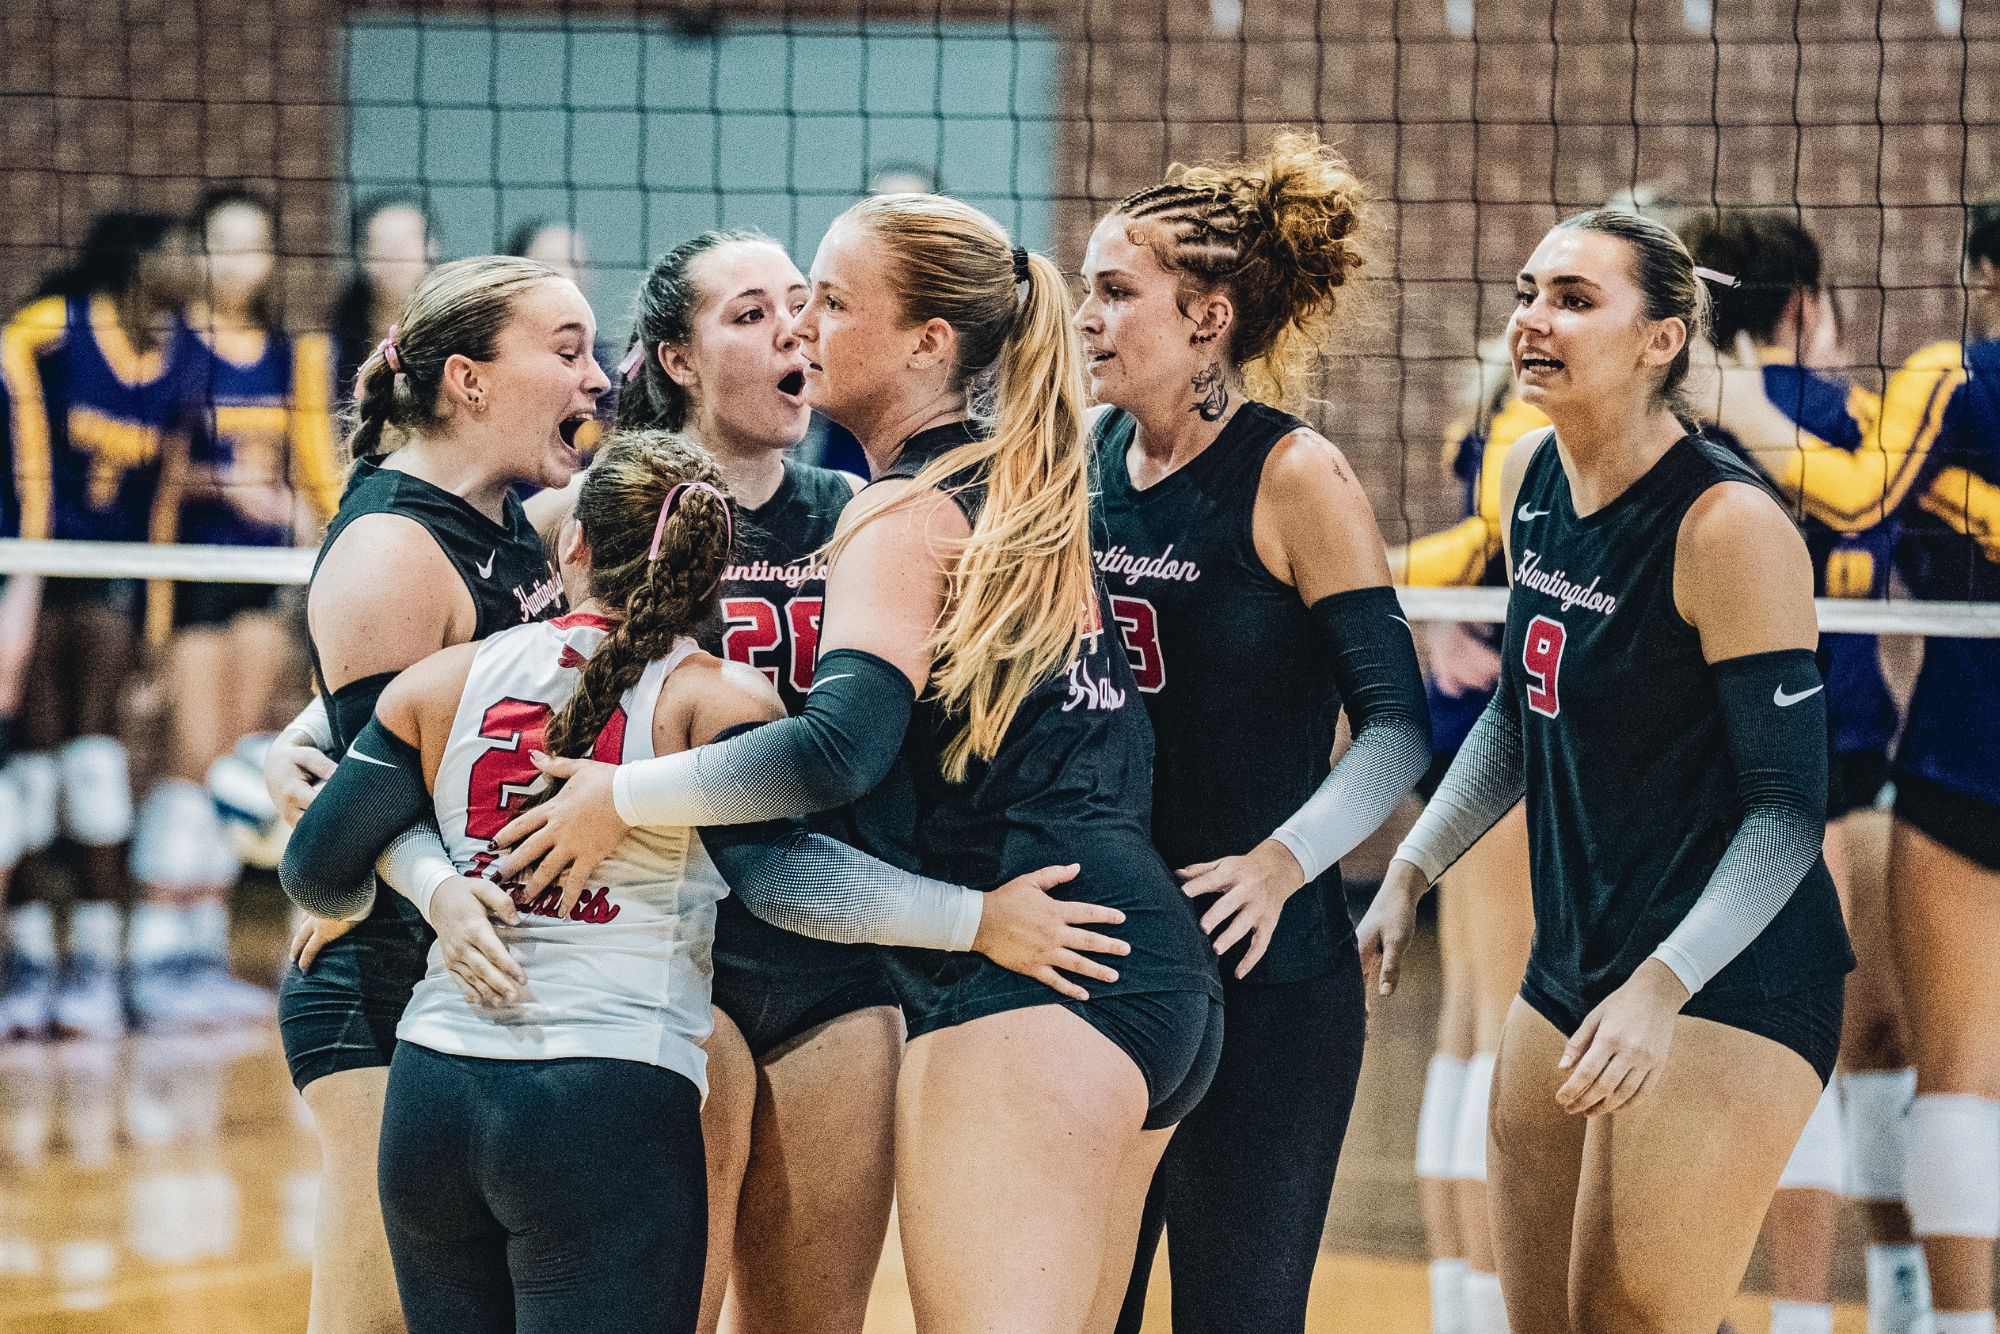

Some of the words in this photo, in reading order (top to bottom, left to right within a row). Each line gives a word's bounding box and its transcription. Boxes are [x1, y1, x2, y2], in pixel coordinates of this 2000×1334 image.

[719, 554, 828, 589] untingd
[1093, 543, 1201, 586] ntingdon
[1514, 549, 1617, 616] Huntingdon
[1109, 594, 1167, 694] 3
[1522, 614, 1568, 720] 9
